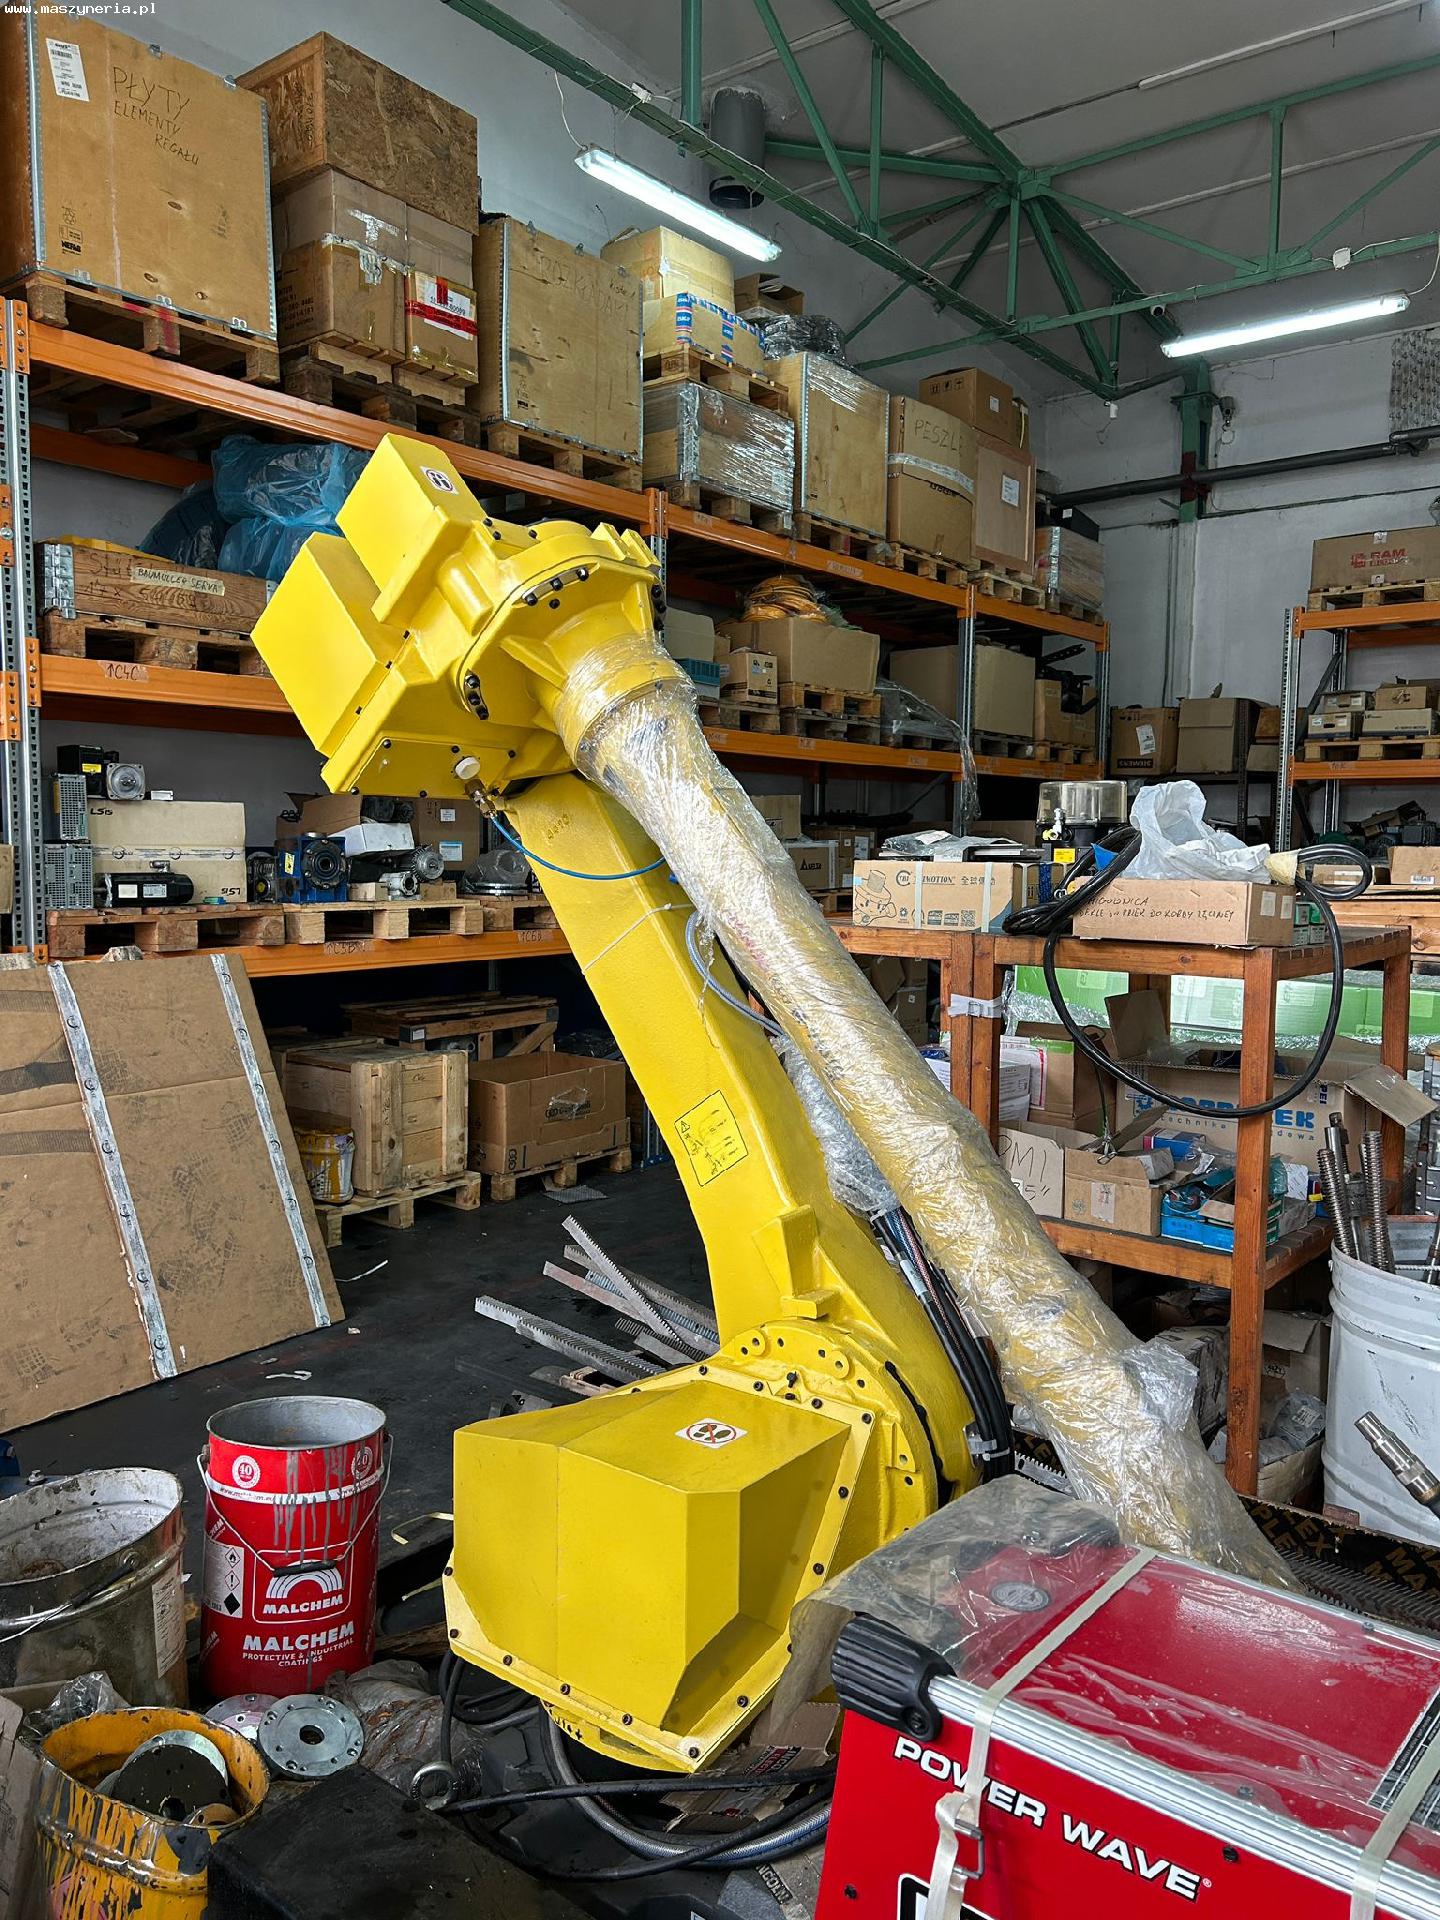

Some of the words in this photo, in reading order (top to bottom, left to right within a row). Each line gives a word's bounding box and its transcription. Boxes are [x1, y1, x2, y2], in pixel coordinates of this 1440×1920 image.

[113, 66, 190, 121] PŁYTY
[114, 100, 181, 136] ELEMENTY
[155, 133, 199, 166] REGAŁU
[190, 577, 219, 592] SERVA
[239, 1463, 253, 1475] 40
[262, 1594, 343, 1615] MALCHEM
[242, 1620, 355, 1652] MALCHEM
[242, 1652, 297, 1662] PROTECTIVE
[894, 1736, 1047, 1828] POWER
